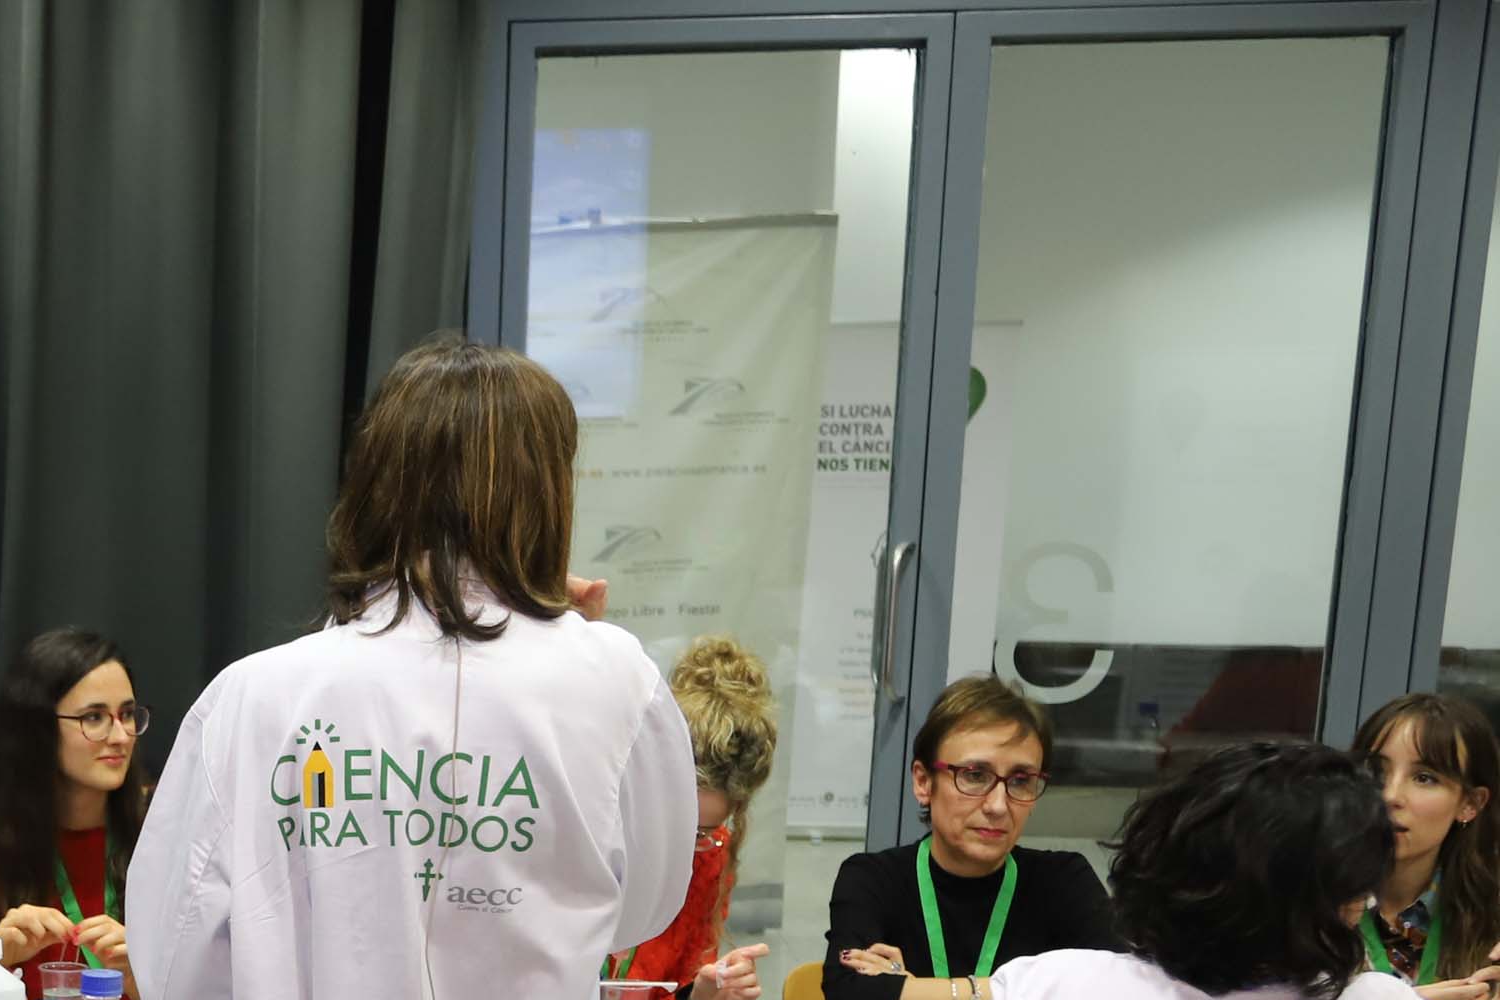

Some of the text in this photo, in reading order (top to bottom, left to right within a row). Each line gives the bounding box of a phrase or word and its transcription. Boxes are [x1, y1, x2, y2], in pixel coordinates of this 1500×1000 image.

[820, 404, 892, 418] SI LUCHA
[819, 423, 884, 437] CONTRA
[818, 441, 836, 454] EL
[817, 458, 890, 472] NOS TIEN
[382, 808, 537, 853] TODOS
[446, 885, 524, 907] aecc
